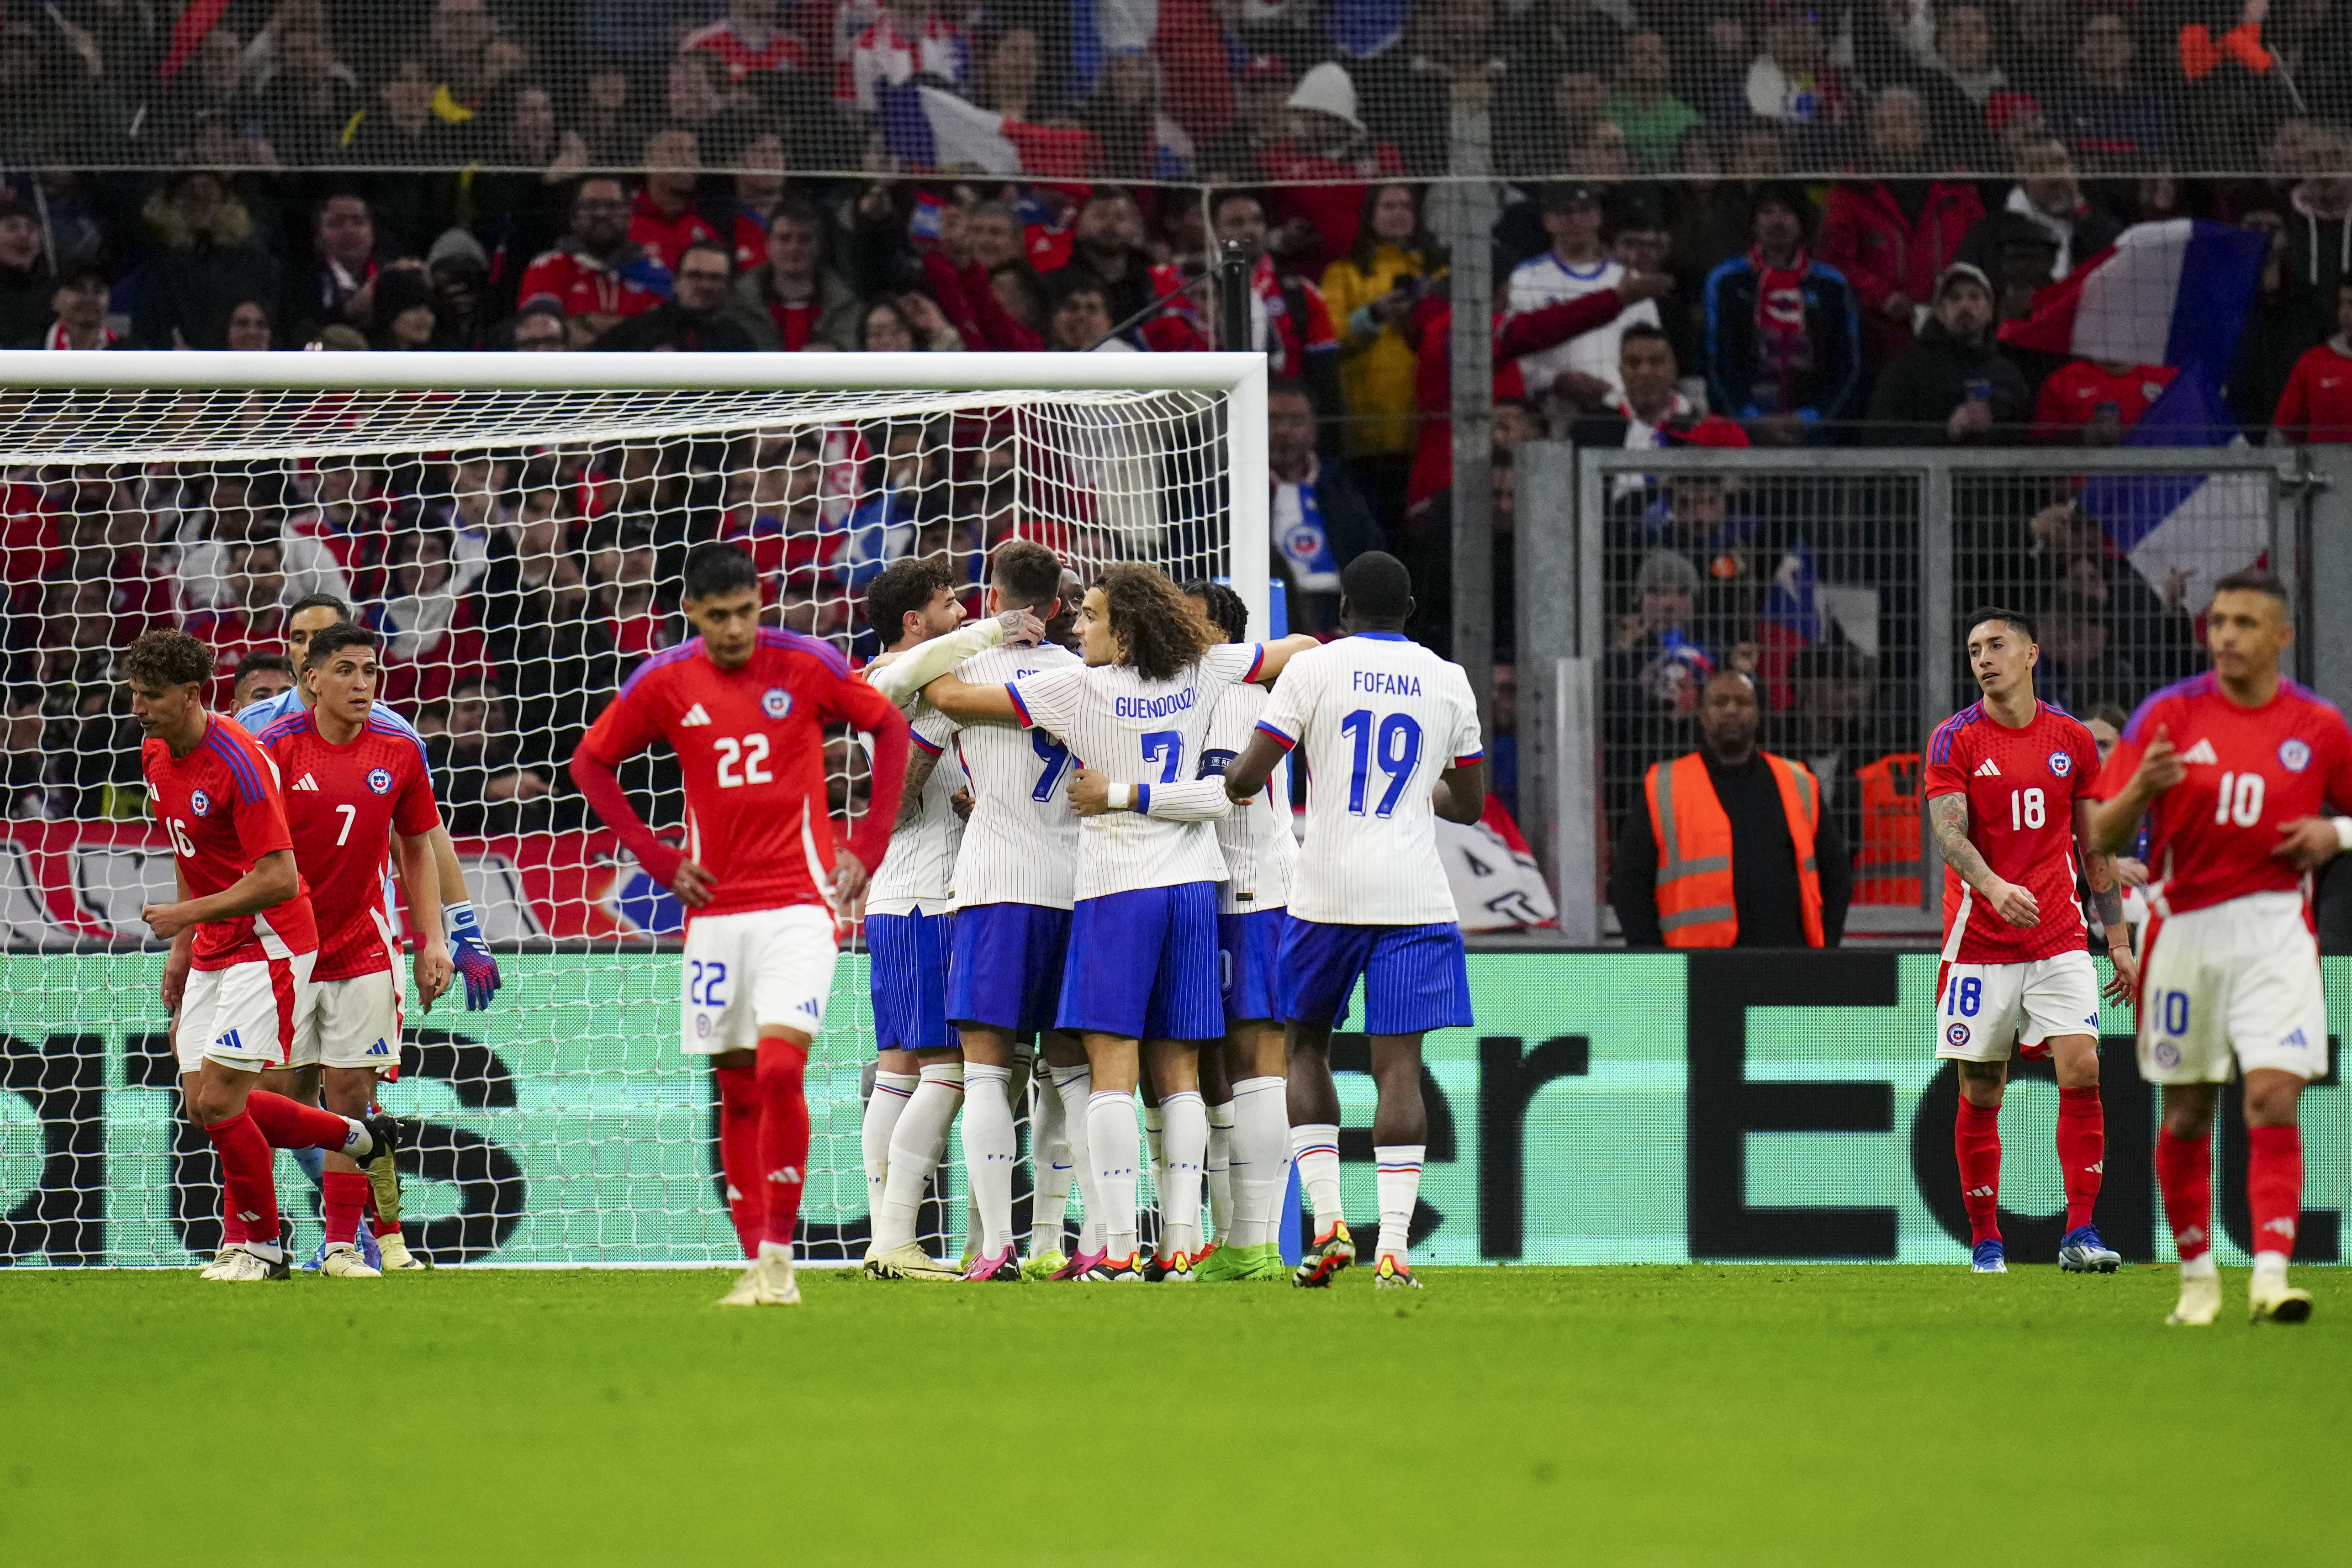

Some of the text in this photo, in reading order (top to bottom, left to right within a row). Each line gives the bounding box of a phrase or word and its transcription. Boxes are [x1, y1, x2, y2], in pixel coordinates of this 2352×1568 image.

[1116, 686, 1195, 718] GUENDOUZI
[1354, 670, 1421, 697] FOFANA
[714, 733, 773, 788] 22
[1032, 727, 1072, 802] 9
[1141, 729, 1184, 784] 7
[1342, 709, 1423, 818] 19
[2011, 788, 2045, 831] 18
[2215, 771, 2265, 828] 10
[166, 816, 196, 858] 16
[336, 804, 356, 846] 7
[692, 961, 725, 1006] 22
[1947, 976, 1982, 1017] 18
[2154, 989, 2189, 1037] 10
